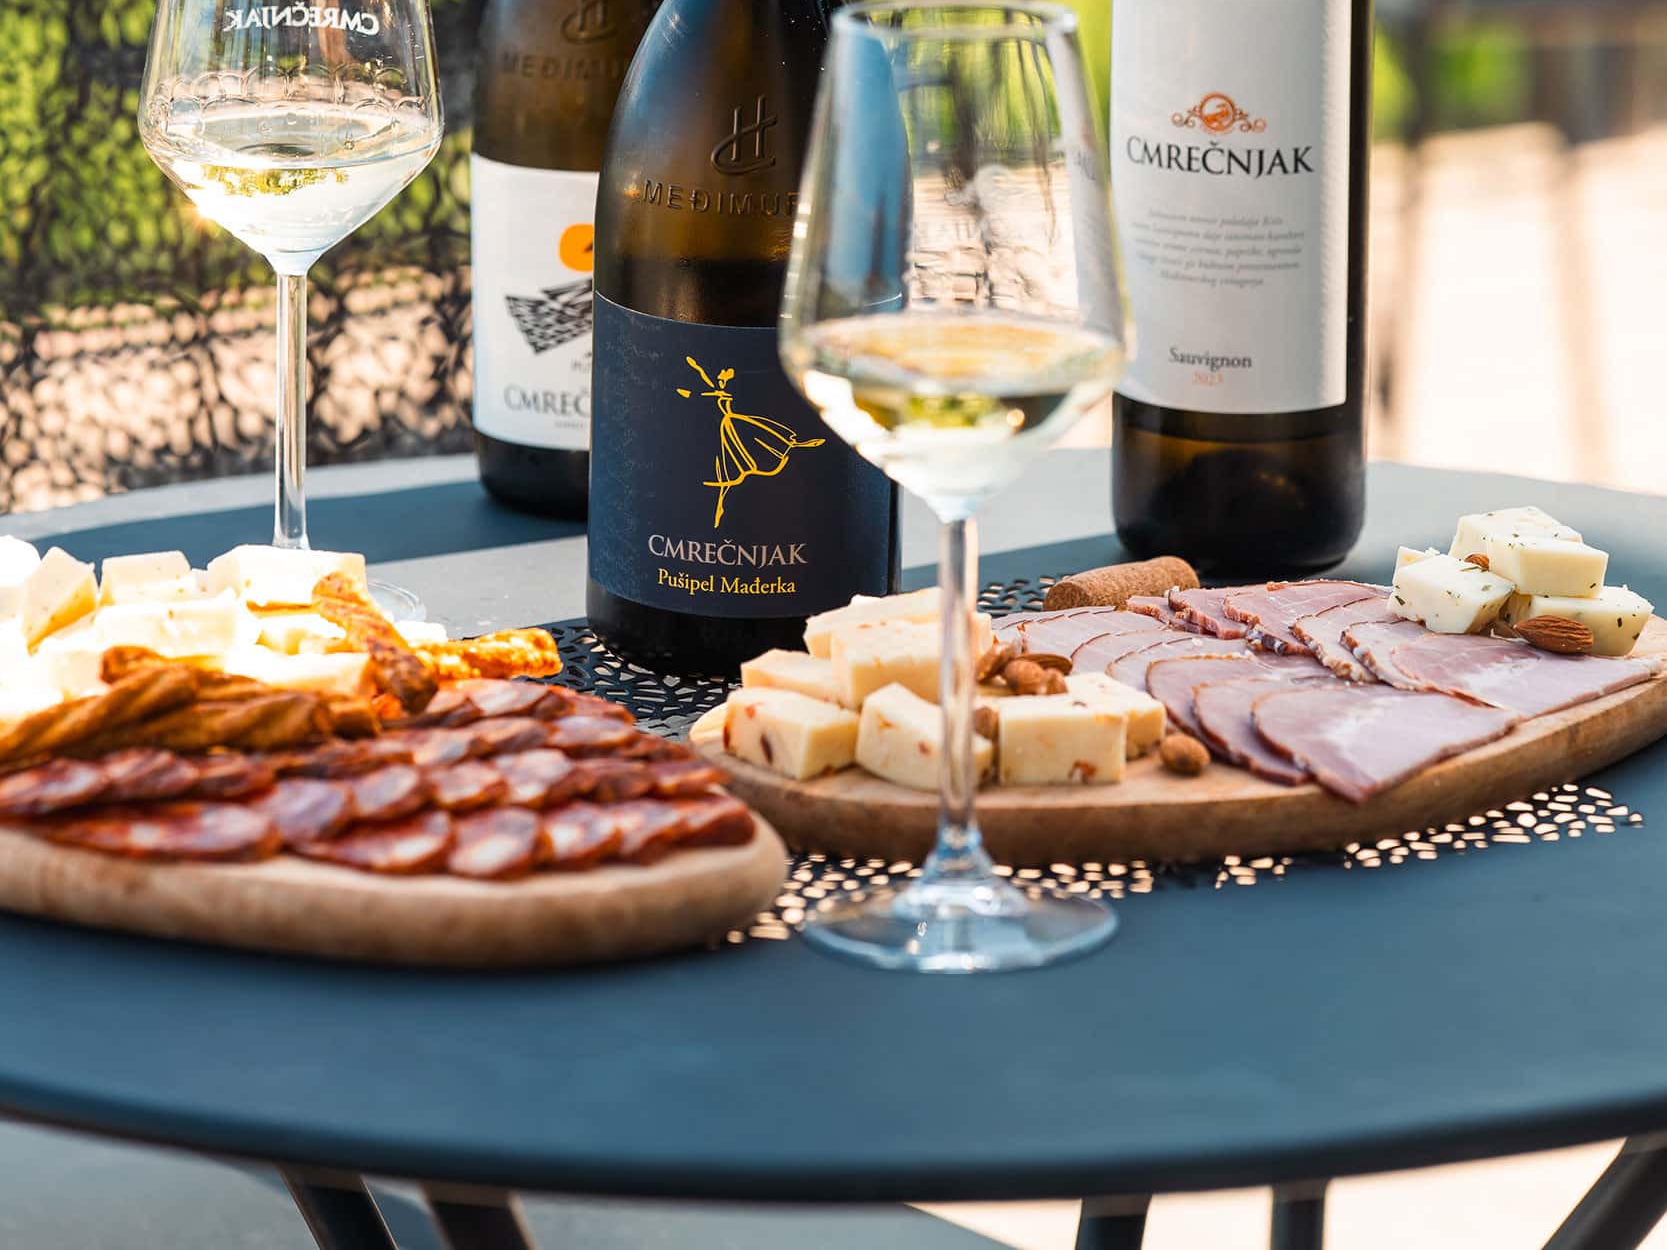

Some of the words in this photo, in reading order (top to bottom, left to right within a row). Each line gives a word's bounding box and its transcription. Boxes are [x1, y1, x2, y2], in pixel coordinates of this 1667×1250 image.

[1127, 135, 1315, 180] CMREČNJAK
[1168, 347, 1253, 372] Sauvignon
[648, 534, 809, 569] CMREČNJAK
[658, 567, 715, 596] Pušipel
[720, 576, 796, 595] Mađerka
